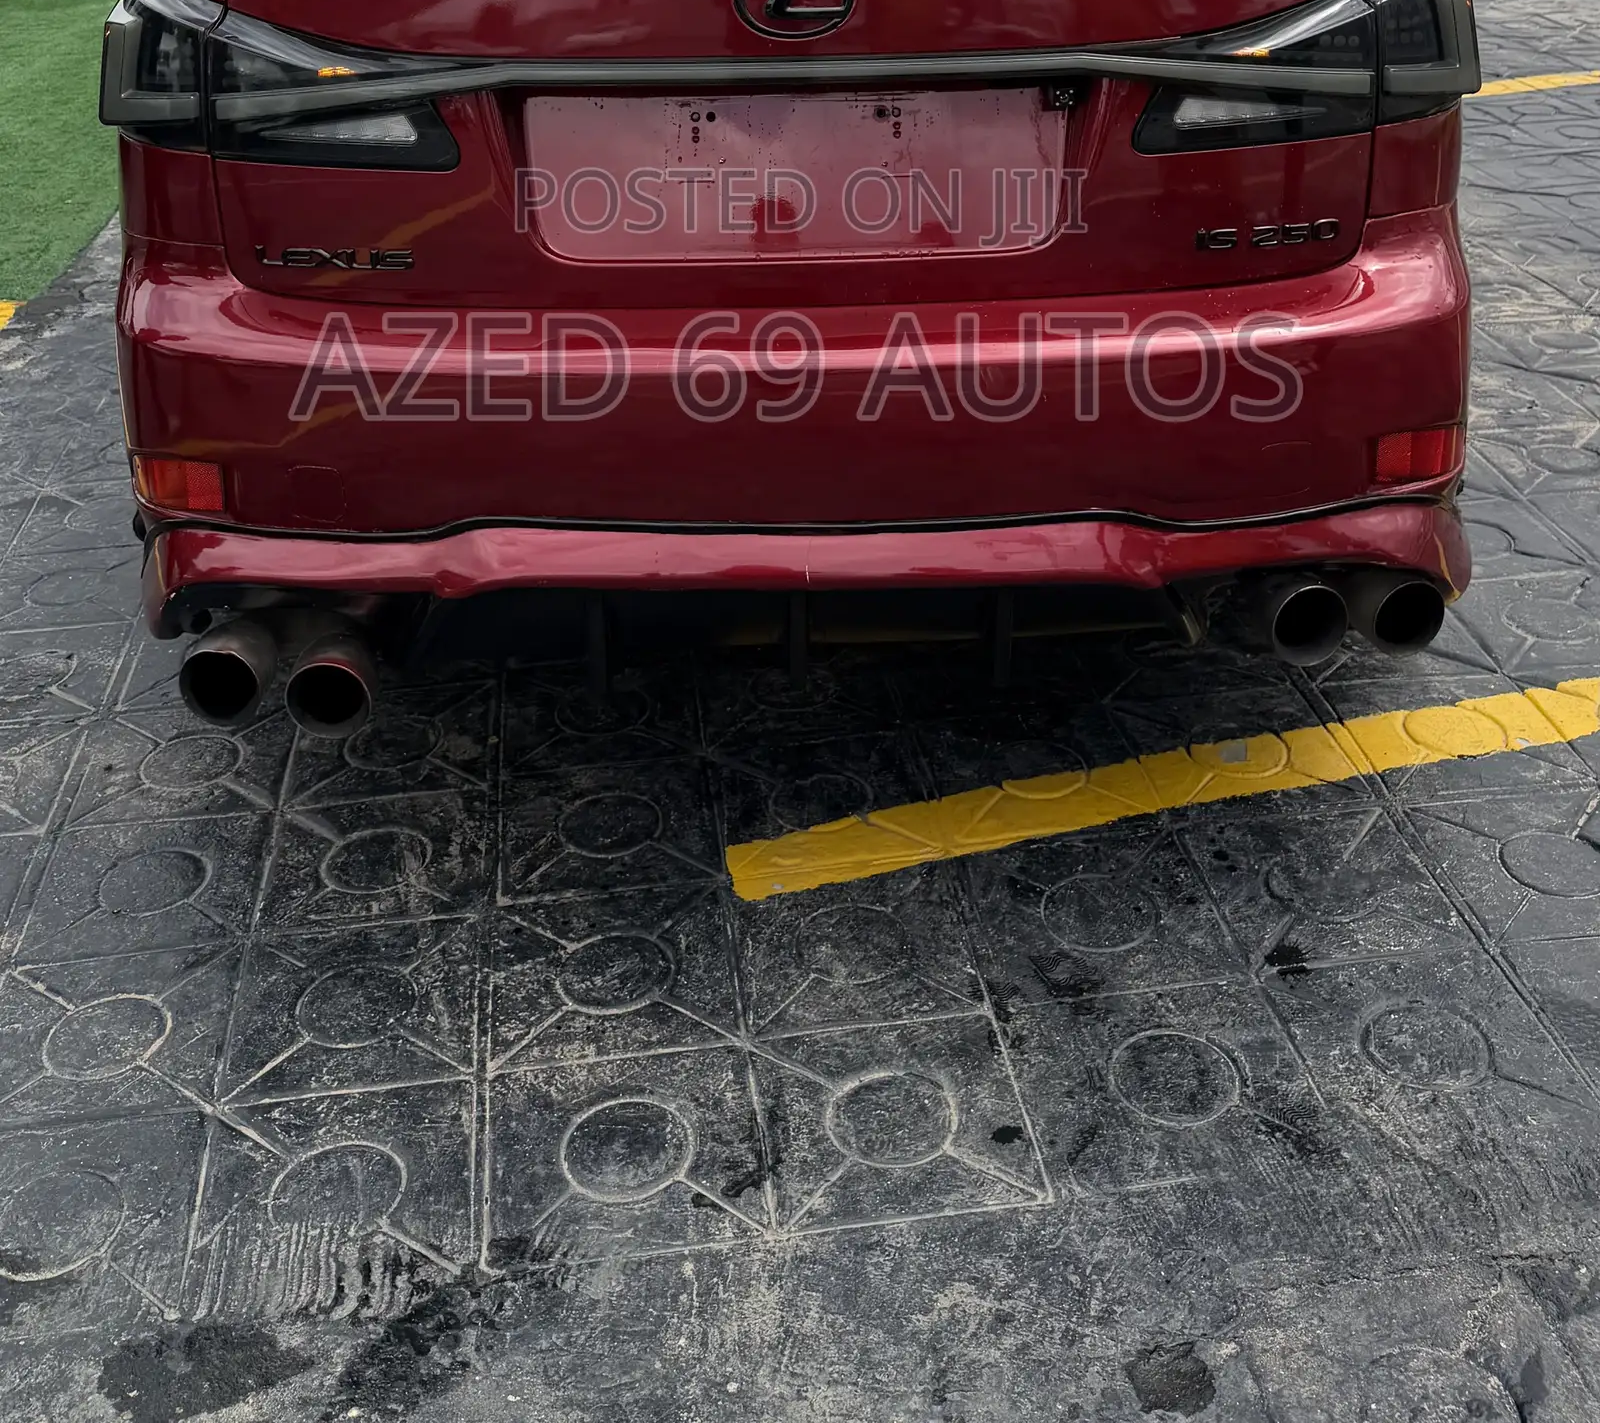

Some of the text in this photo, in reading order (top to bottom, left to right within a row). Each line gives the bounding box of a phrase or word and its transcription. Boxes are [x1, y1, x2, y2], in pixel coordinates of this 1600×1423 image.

[1195, 217, 1340, 250] IS 250
[255, 244, 415, 270] LEXUS
